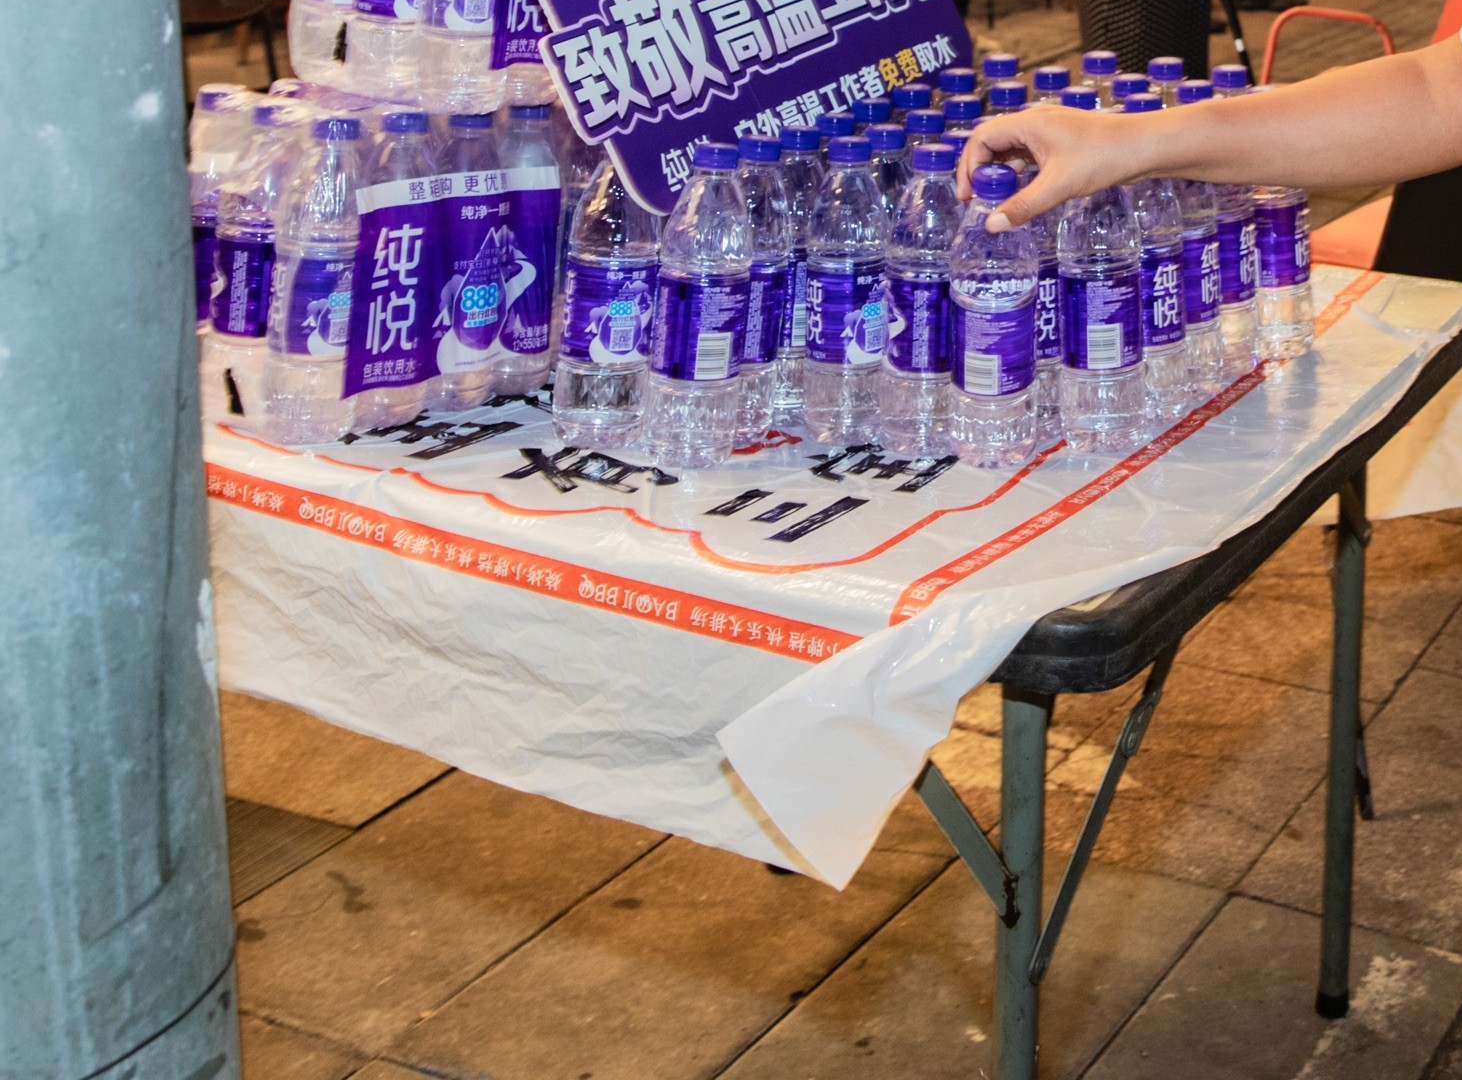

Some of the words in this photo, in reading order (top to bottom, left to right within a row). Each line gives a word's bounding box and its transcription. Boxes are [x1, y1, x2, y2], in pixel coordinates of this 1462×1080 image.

[365, 223, 424, 355] 纯悦
[1201, 242, 1221, 305] 纯悦
[461, 282, 498, 312] 888
[609, 301, 633, 317] 888
[1153, 264, 1180, 329] 纯悦
[363, 358, 416, 378] 包装饮用水
[298, 496, 336, 528] BBQ
[392, 528, 474, 569] 快乐大排场
[476, 552, 563, 592] 烧烤小牌档
[578, 573, 618, 607] BBQ
[689, 605, 784, 647] 快乐大排场
